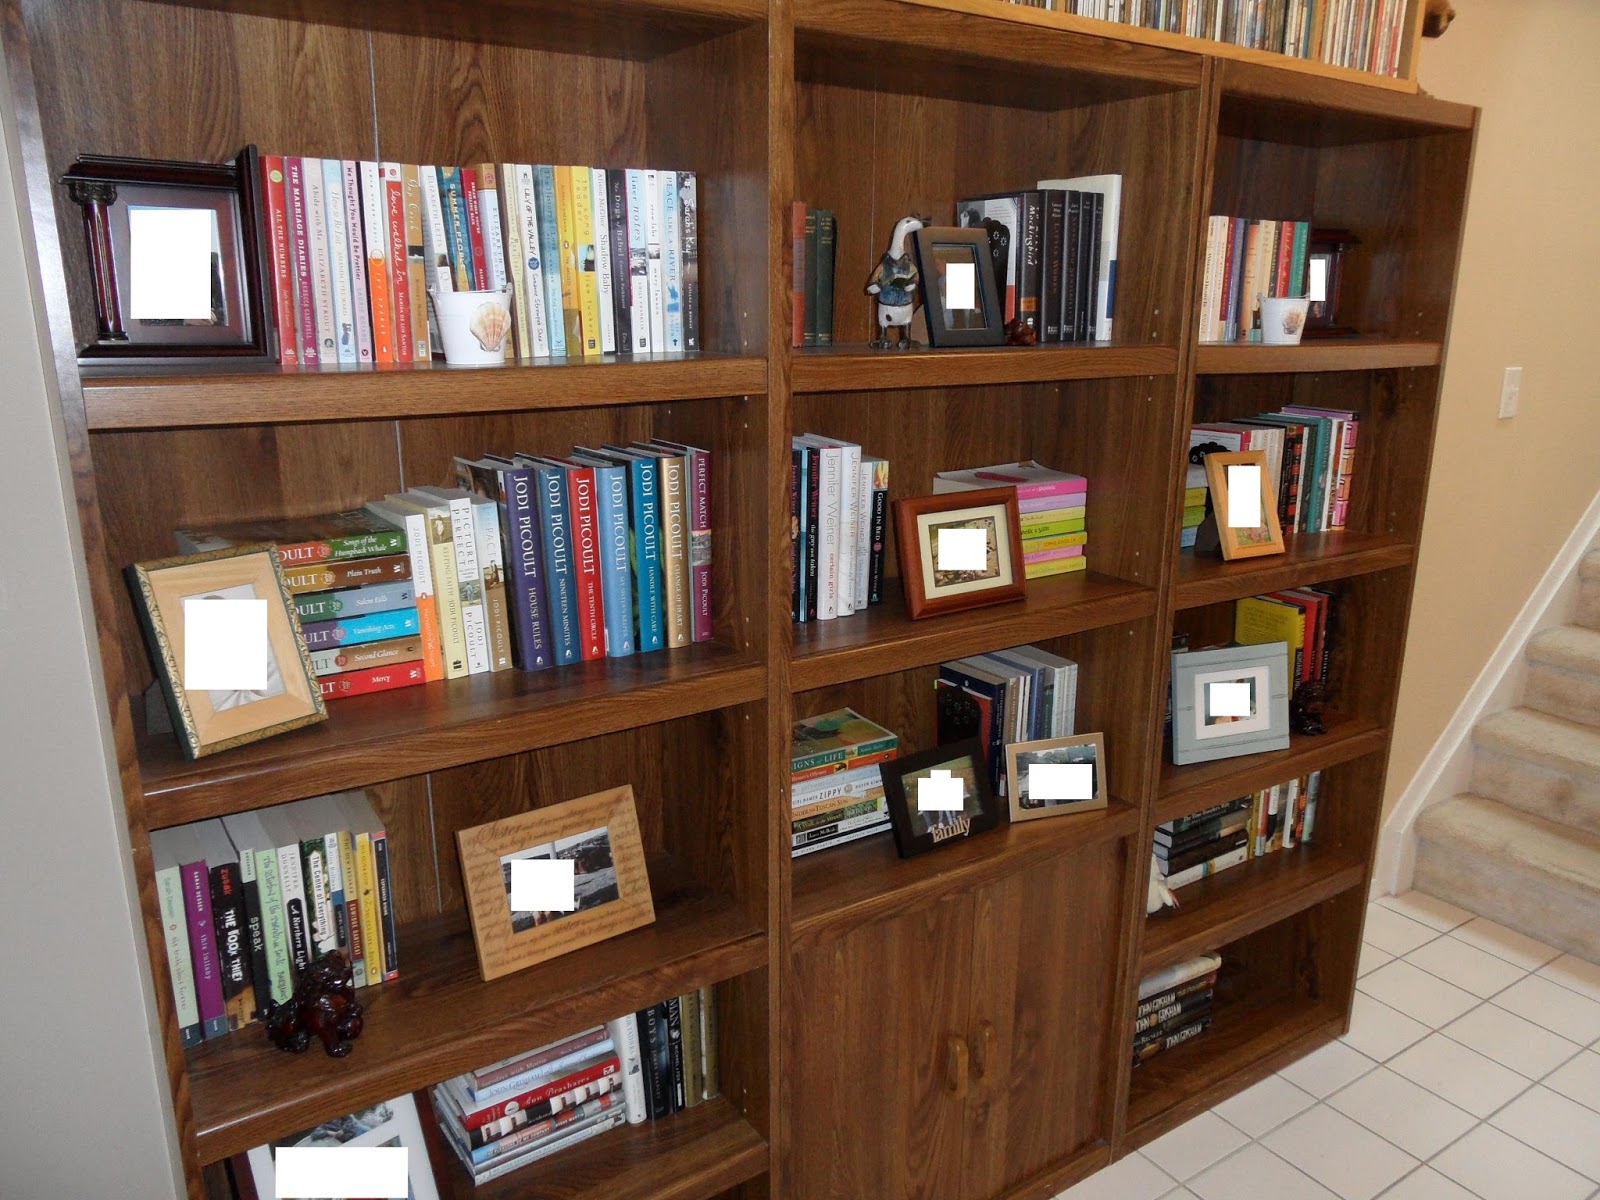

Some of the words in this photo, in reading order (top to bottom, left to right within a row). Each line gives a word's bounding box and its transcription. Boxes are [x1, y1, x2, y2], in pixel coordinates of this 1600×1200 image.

[347, 179, 356, 207] Thought
[390, 189, 400, 216] love
[427, 175, 439, 220] ELIZABETH
[631, 176, 639, 201] liner
[349, 209, 357, 221] You
[527, 205, 532, 214] OF
[614, 195, 622, 219] Dogs
[684, 199, 693, 233] Sarah's
[293, 188, 303, 235] MARRIAGE
[298, 240, 306, 276] DIARIES
[450, 184, 460, 227] SUMMER
[455, 231, 466, 270] PEOPLE
[493, 208, 503, 264] ELIZABETH
[633, 206, 642, 241] notes
[1025, 205, 1035, 265] Mockingbird
[353, 245, 358, 253] Be
[392, 221, 403, 265] walked
[528, 230, 536, 255] VALLEY
[600, 234, 609, 270] Shadow
[684, 237, 694, 254] Key
[396, 269, 406, 284] in
[601, 274, 610, 295] Baby
[322, 300, 330, 333] STROUT
[546, 474, 561, 507] JODI
[610, 475, 623, 507] JODI
[641, 464, 654, 496] JODI
[668, 464, 681, 495] JODI
[826, 454, 838, 497] Jennifer
[514, 476, 529, 509] JODI
[577, 478, 590, 511] JODI
[643, 503, 656, 560] PICOULT
[670, 502, 682, 559] PICOULT
[827, 502, 837, 545] Weiner
[877, 516, 882, 524] IN
[452, 509, 465, 566] PERFECT
[462, 508, 474, 565] PICTURE
[486, 528, 495, 556] PACT
[519, 516, 536, 577] PICOULT
[551, 514, 567, 574] PICOULT
[580, 516, 595, 574] PICOULT
[614, 514, 626, 572] PICOULT
[364, 567, 381, 575] Truth
[528, 587, 539, 620] HOUSE
[559, 579, 567, 613] NINETEEN
[466, 612, 475, 658] PICOULT
[475, 621, 483, 646] JODI
[496, 620, 504, 653] PICOULT
[532, 622, 542, 649] RULES
[355, 651, 376, 661] Second
[377, 649, 399, 658] Glance
[372, 675, 390, 684] Mercy
[792, 759, 815, 770] IGNS
[824, 752, 844, 762] LIFE
[819, 787, 843, 800] ZIPPY
[932, 816, 971, 843] family
[314, 870, 322, 891] Center
[224, 910, 236, 928] THE
[247, 916, 265, 952] speak
[291, 917, 304, 949] Northern
[315, 902, 328, 936] Everything
[200, 934, 209, 950] this
[224, 929, 242, 956] BOOK
[200, 952, 214, 980] lullaby
[229, 957, 244, 983] THIEF
[295, 950, 308, 971] Light
[647, 1010, 657, 1044] BOYS
[668, 999, 679, 1026] MAN
[522, 1093, 543, 1106] Ann
[544, 1075, 591, 1098] Brashares
